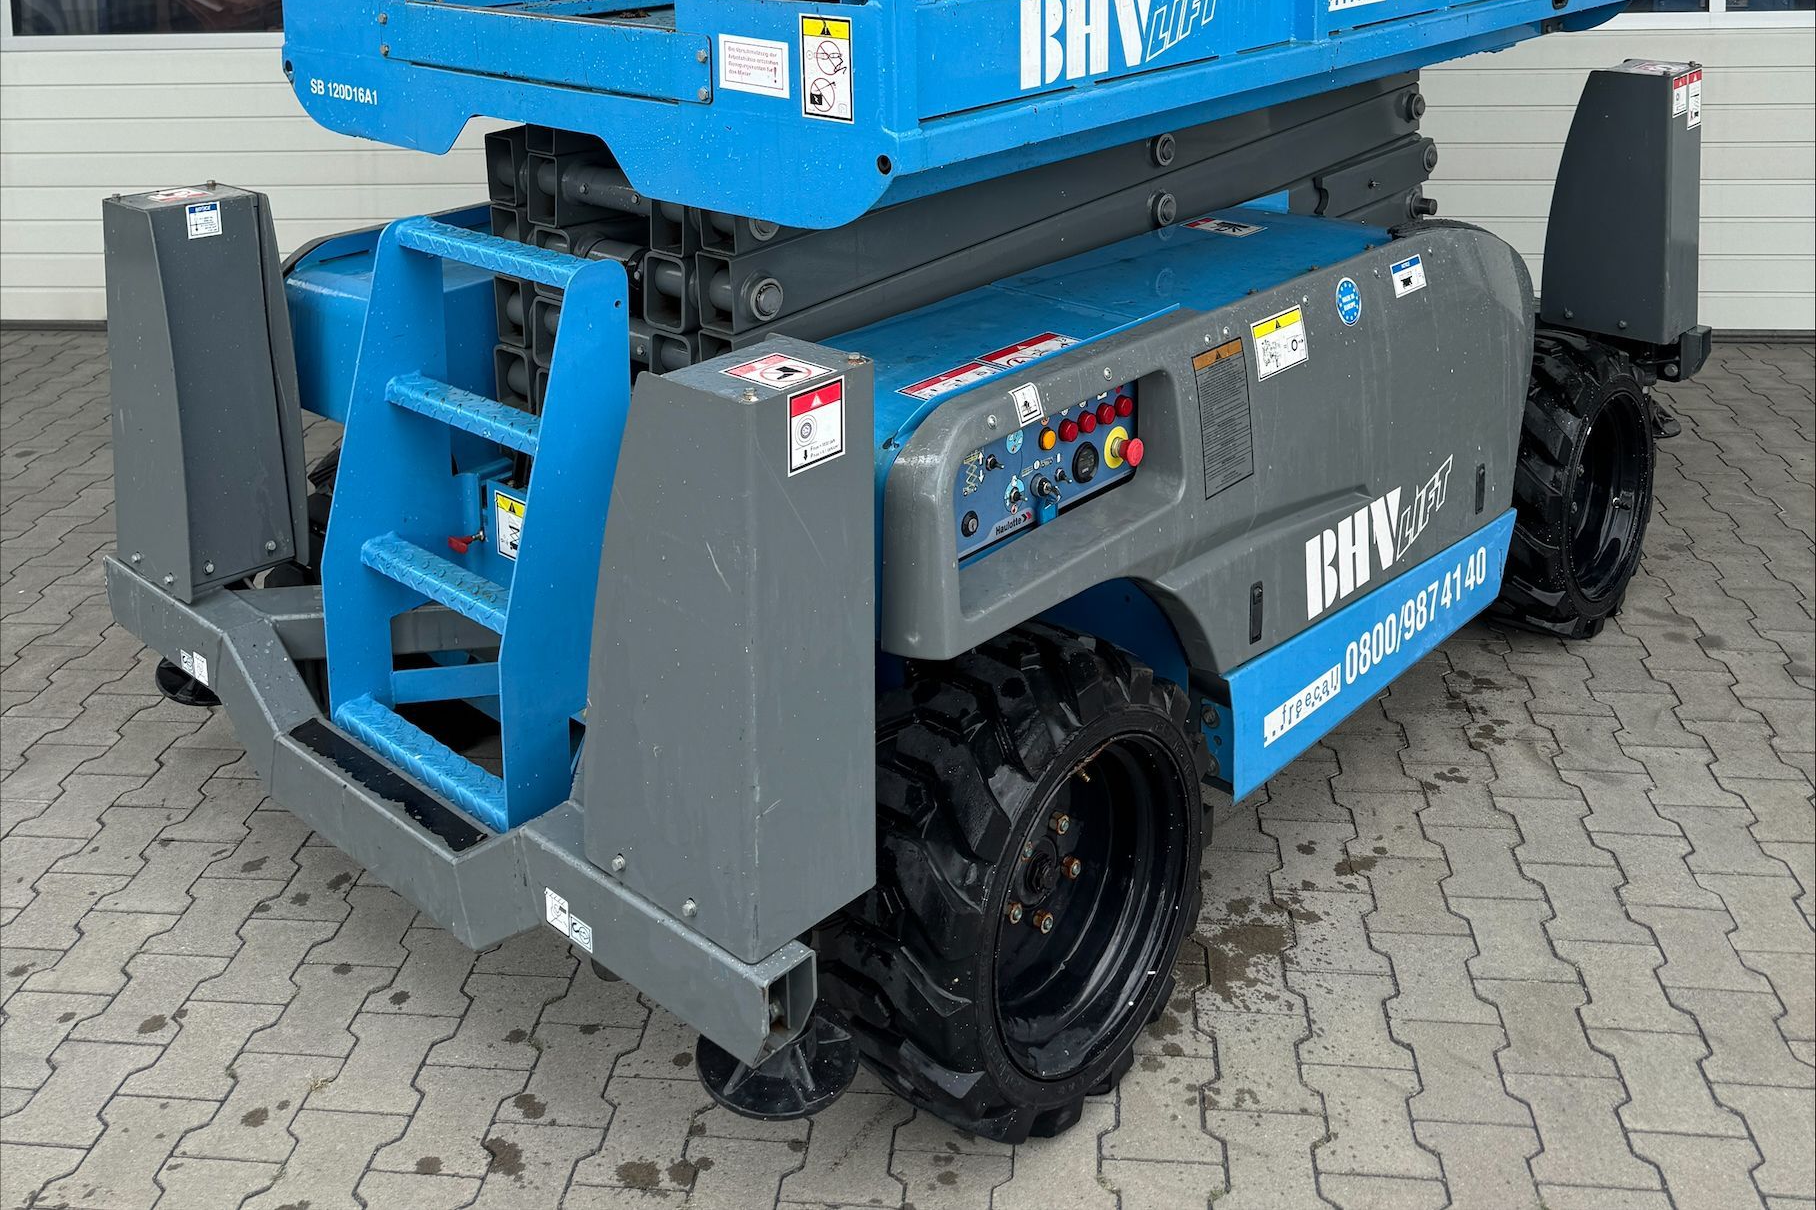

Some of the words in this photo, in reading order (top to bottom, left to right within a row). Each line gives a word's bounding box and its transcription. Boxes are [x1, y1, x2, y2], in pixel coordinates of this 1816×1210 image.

[310, 77, 325, 95] SB
[327, 81, 378, 106] 120D16A1
[995, 517, 1022, 536] Haulotte
[1305, 486, 1402, 621] BHV
[1396, 454, 1453, 562] LIFT
[1345, 546, 1487, 685] 0800/9874140
